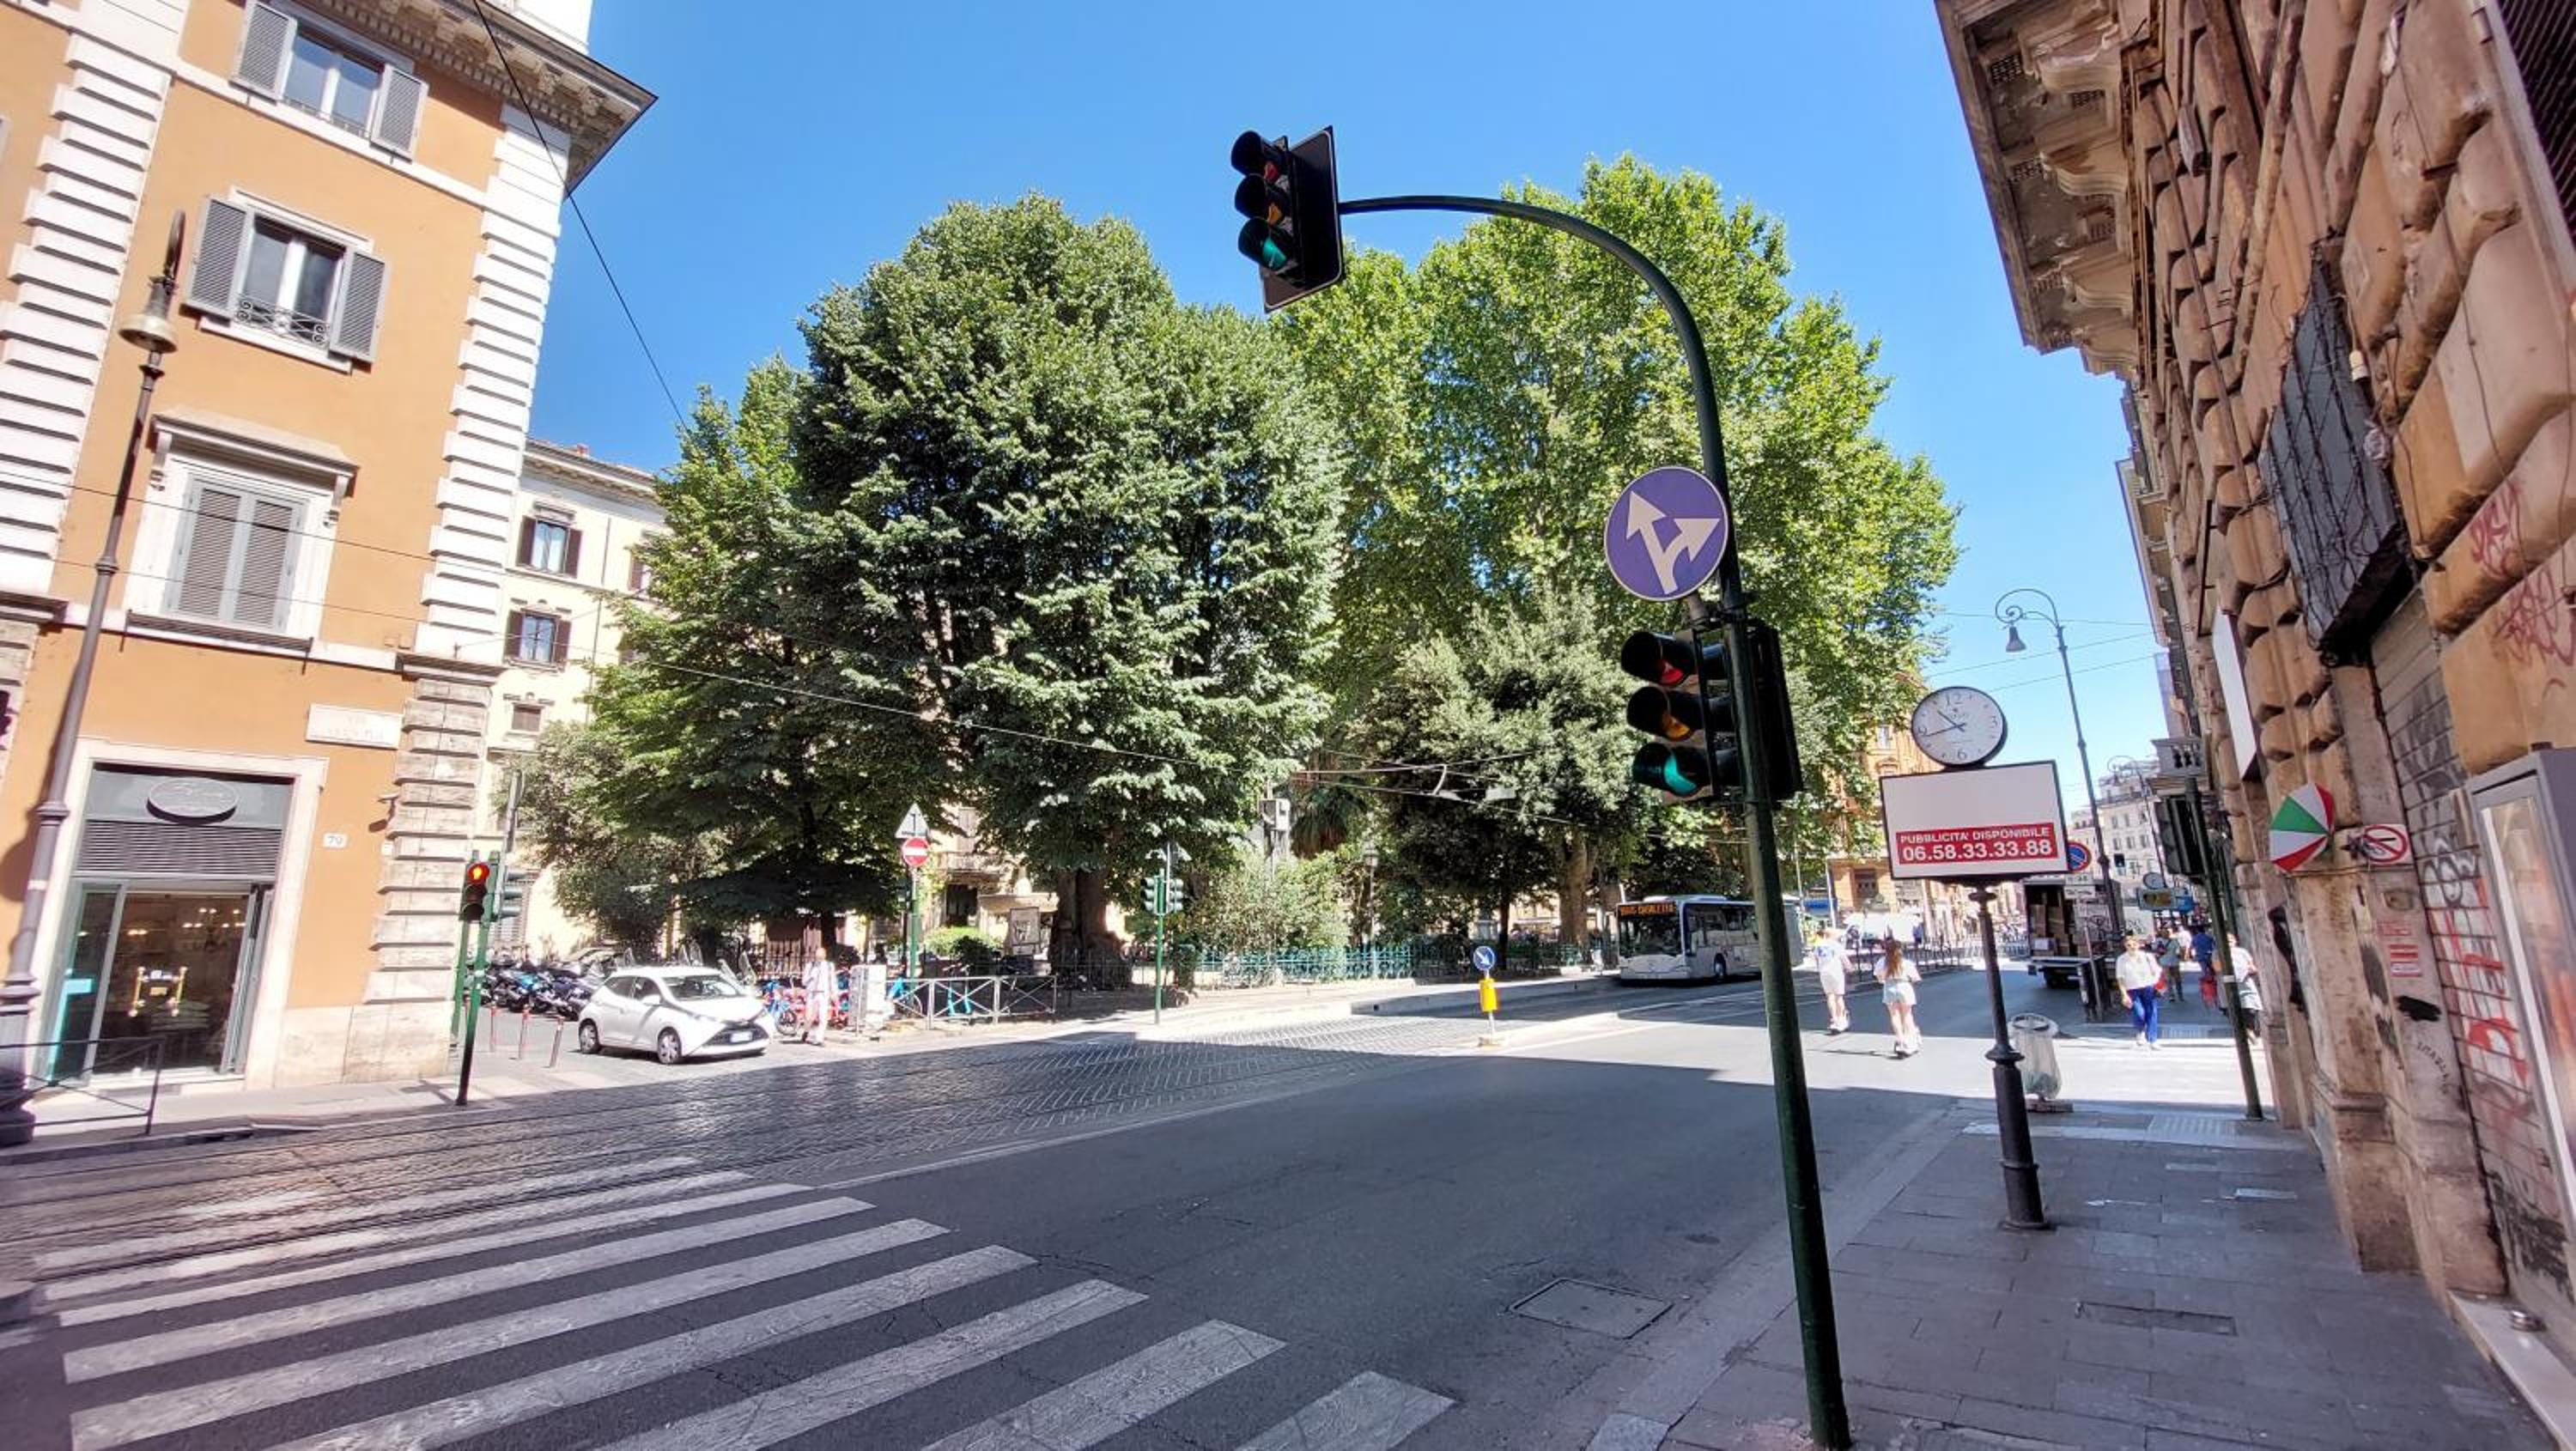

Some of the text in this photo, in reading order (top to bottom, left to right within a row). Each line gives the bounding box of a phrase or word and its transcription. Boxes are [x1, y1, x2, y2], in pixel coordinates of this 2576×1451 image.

[1947, 693, 1963, 706] 12
[1991, 715, 1998, 728] 3
[1917, 725, 1928, 736] 9
[1957, 749, 1967, 760] 6
[1900, 827, 2050, 844] PUBBLICITA' DISPONIBILE
[1902, 840, 2052, 861] 06.58.33.33.88
